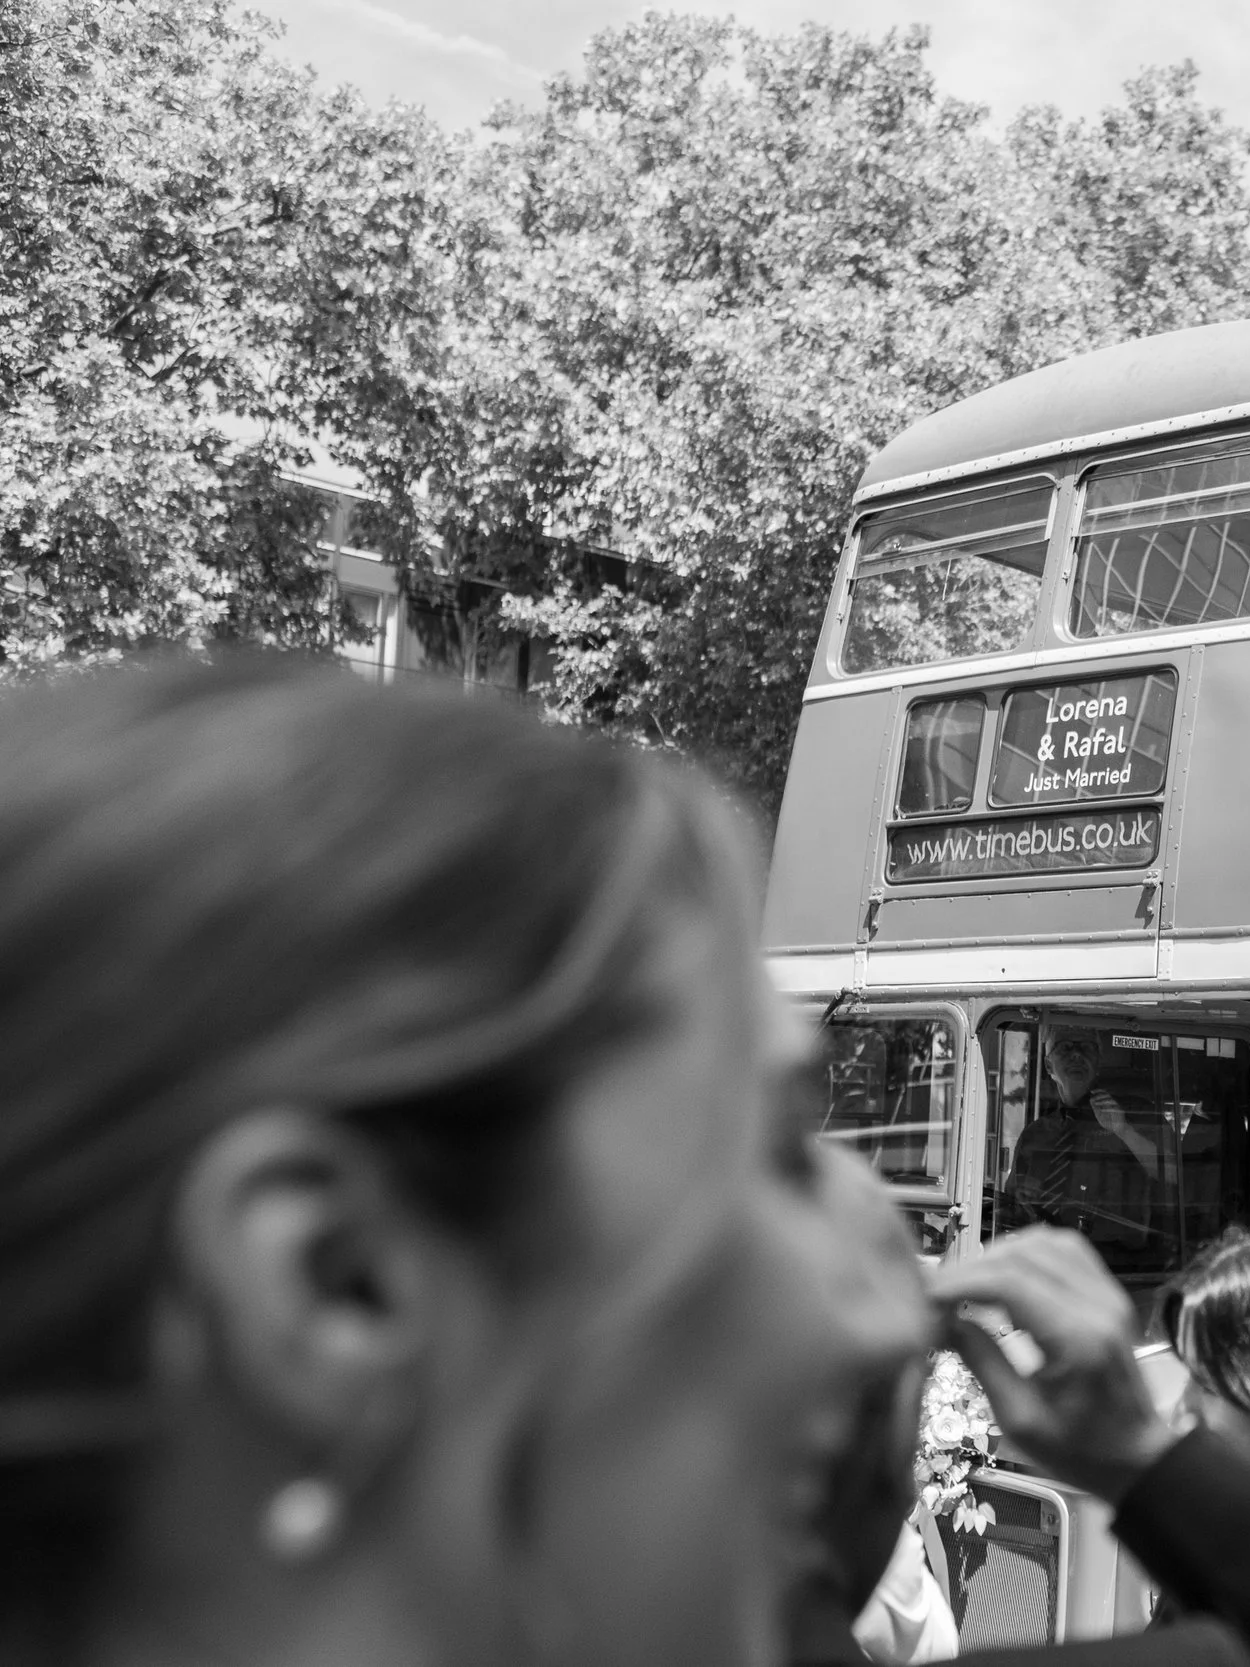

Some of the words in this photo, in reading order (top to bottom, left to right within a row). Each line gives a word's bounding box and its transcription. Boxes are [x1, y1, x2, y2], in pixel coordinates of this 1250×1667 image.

[1046, 696, 1128, 724] Lorena
[1037, 734, 1056, 761] &
[1063, 726, 1126, 759] Rafal
[1023, 772, 1061, 793] Just
[1064, 762, 1132, 789] Married
[906, 812, 1154, 865] www.timebus.co.uk
[1114, 1037, 1144, 1048] EMERGENCY
[1145, 1040, 1157, 1050] EXIT
